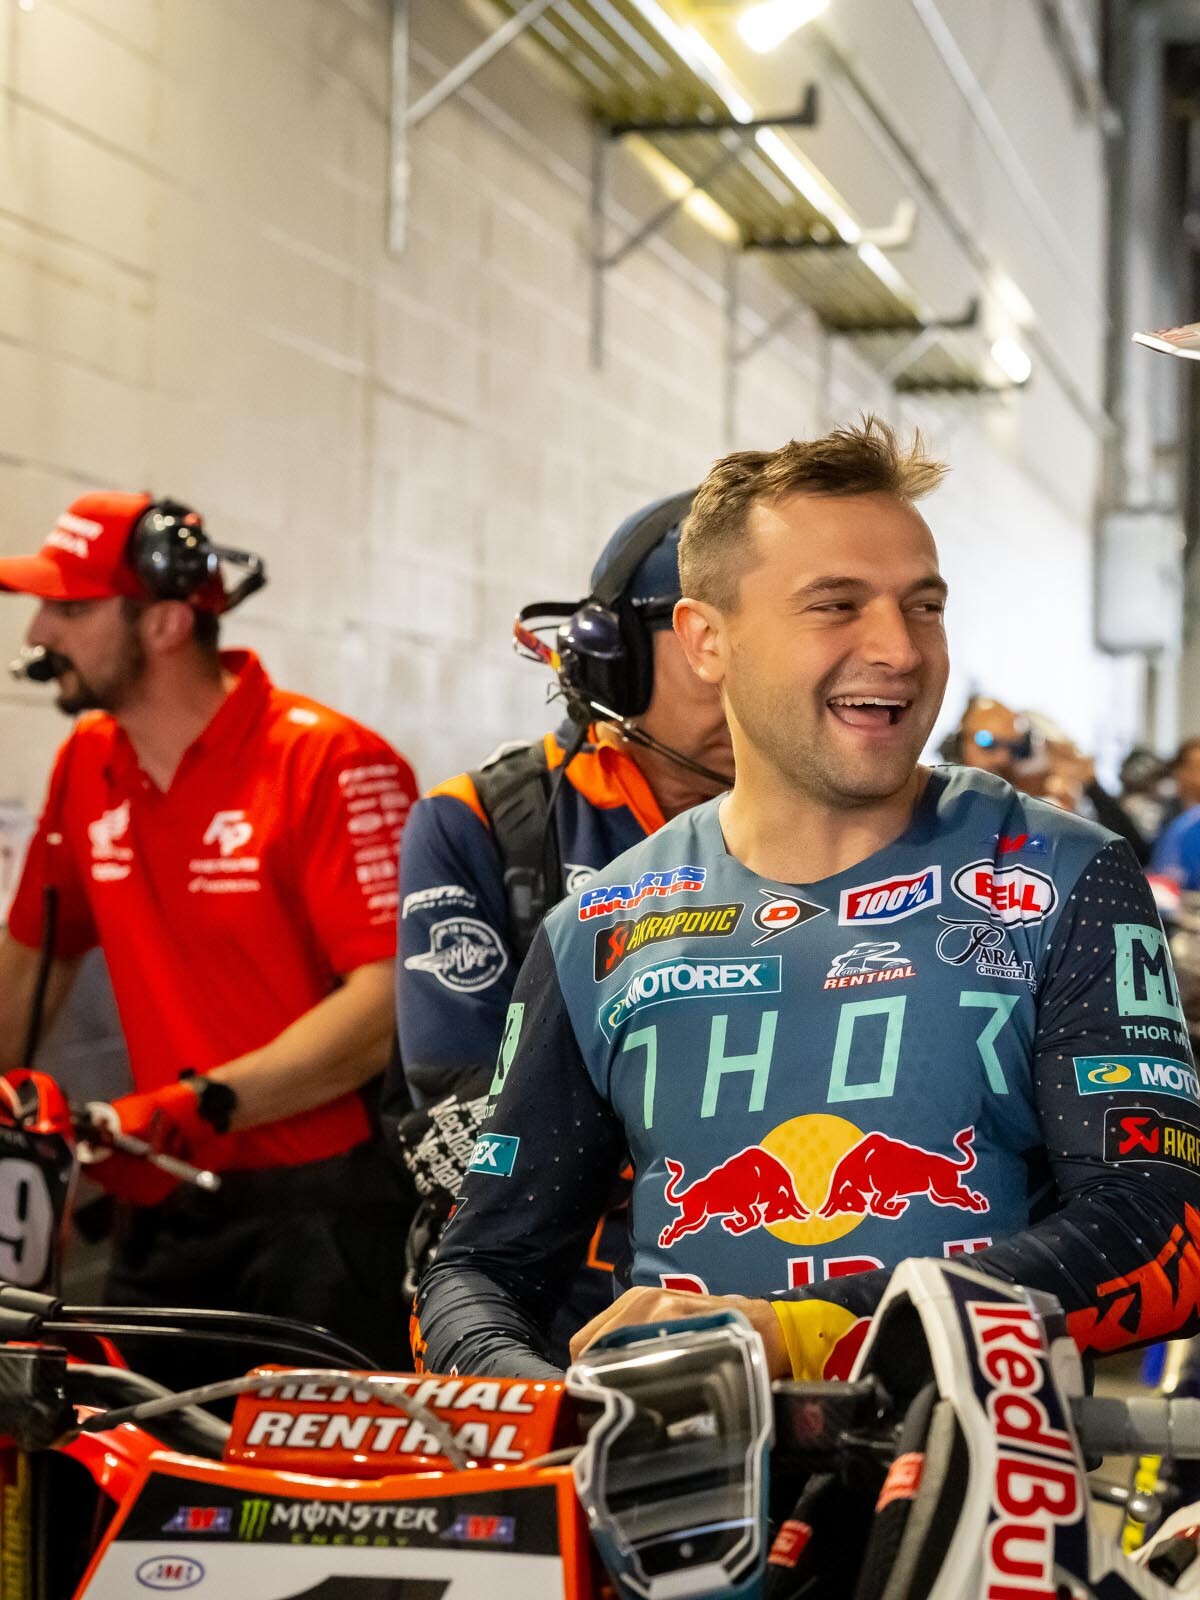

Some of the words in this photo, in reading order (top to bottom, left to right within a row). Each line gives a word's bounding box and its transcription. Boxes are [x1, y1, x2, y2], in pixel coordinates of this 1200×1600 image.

[579, 866, 706, 909] PARTS
[854, 874, 927, 917] 100%
[975, 872, 1041, 912] BELL
[625, 963, 762, 1009] MOTOREX
[822, 965, 917, 990] RENTHAL
[1121, 1025, 1171, 1042] THOR
[966, 1302, 1073, 1455] Red
[271, 1500, 439, 1533] MONSTER
